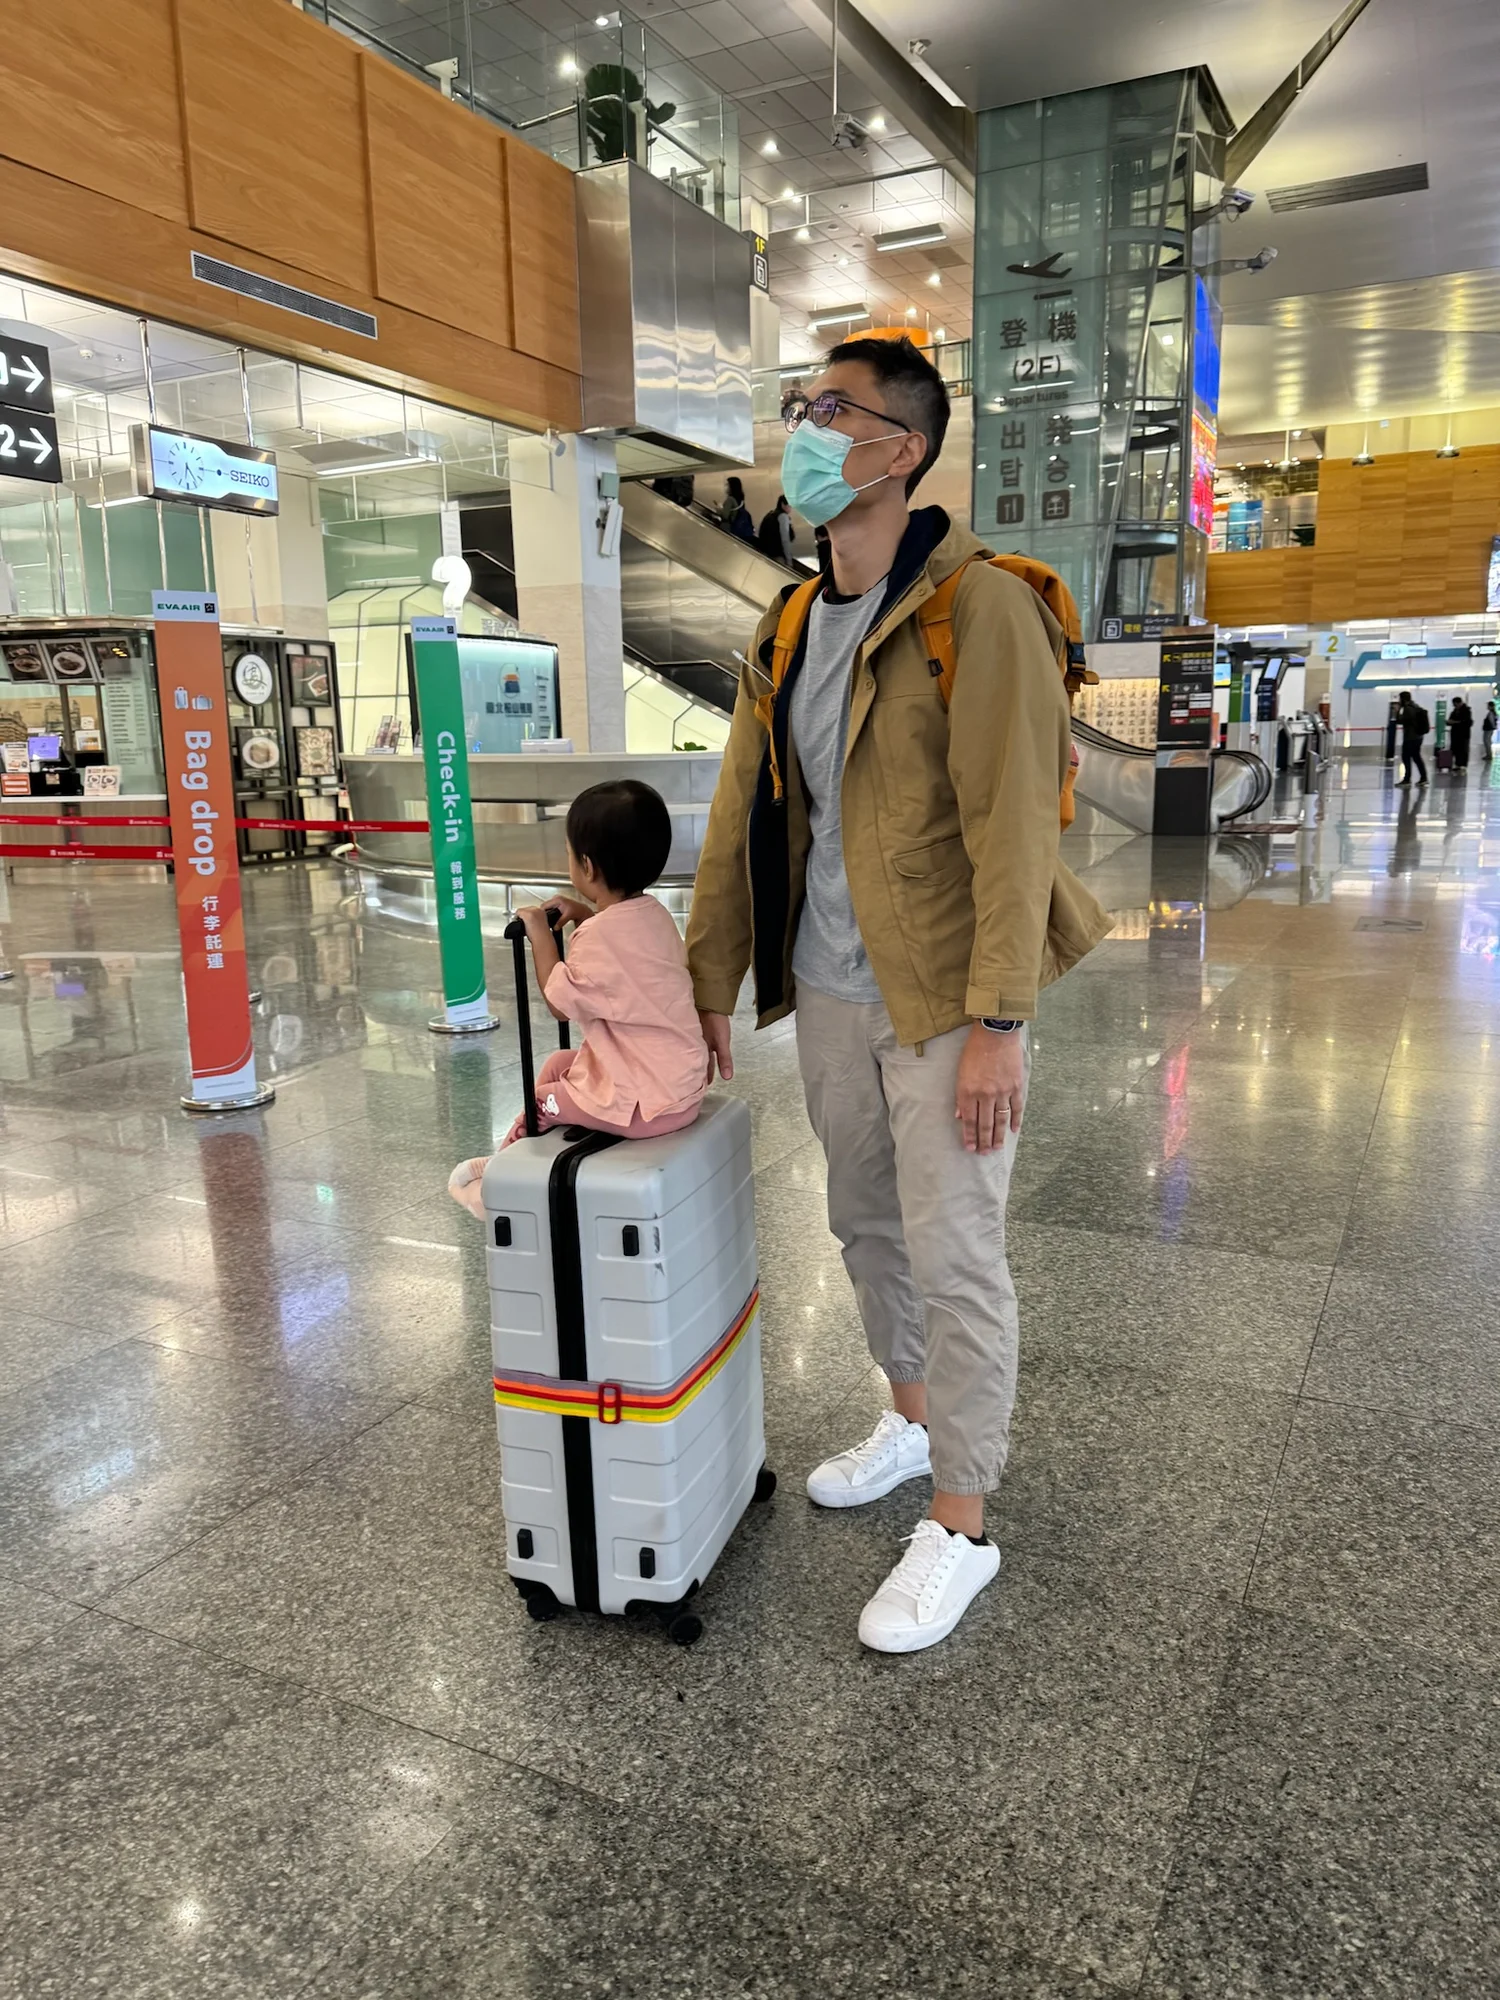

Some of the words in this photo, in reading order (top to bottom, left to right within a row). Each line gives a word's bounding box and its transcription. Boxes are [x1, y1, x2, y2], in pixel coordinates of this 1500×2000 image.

[755, 236, 766, 254] 1F
[1000, 310, 1078, 350] 登機
[1013, 355, 1062, 383] (2F)
[0, 424, 18, 458] 2
[230, 469, 270, 488] SEIKO
[1000, 454, 1071, 488] 탑승
[1327, 635, 1339, 653] 2
[181, 731, 212, 790] Bag
[437, 730, 463, 843] Check-in
[188, 800, 219, 876] drop
[202, 896, 224, 969] 行李託運
